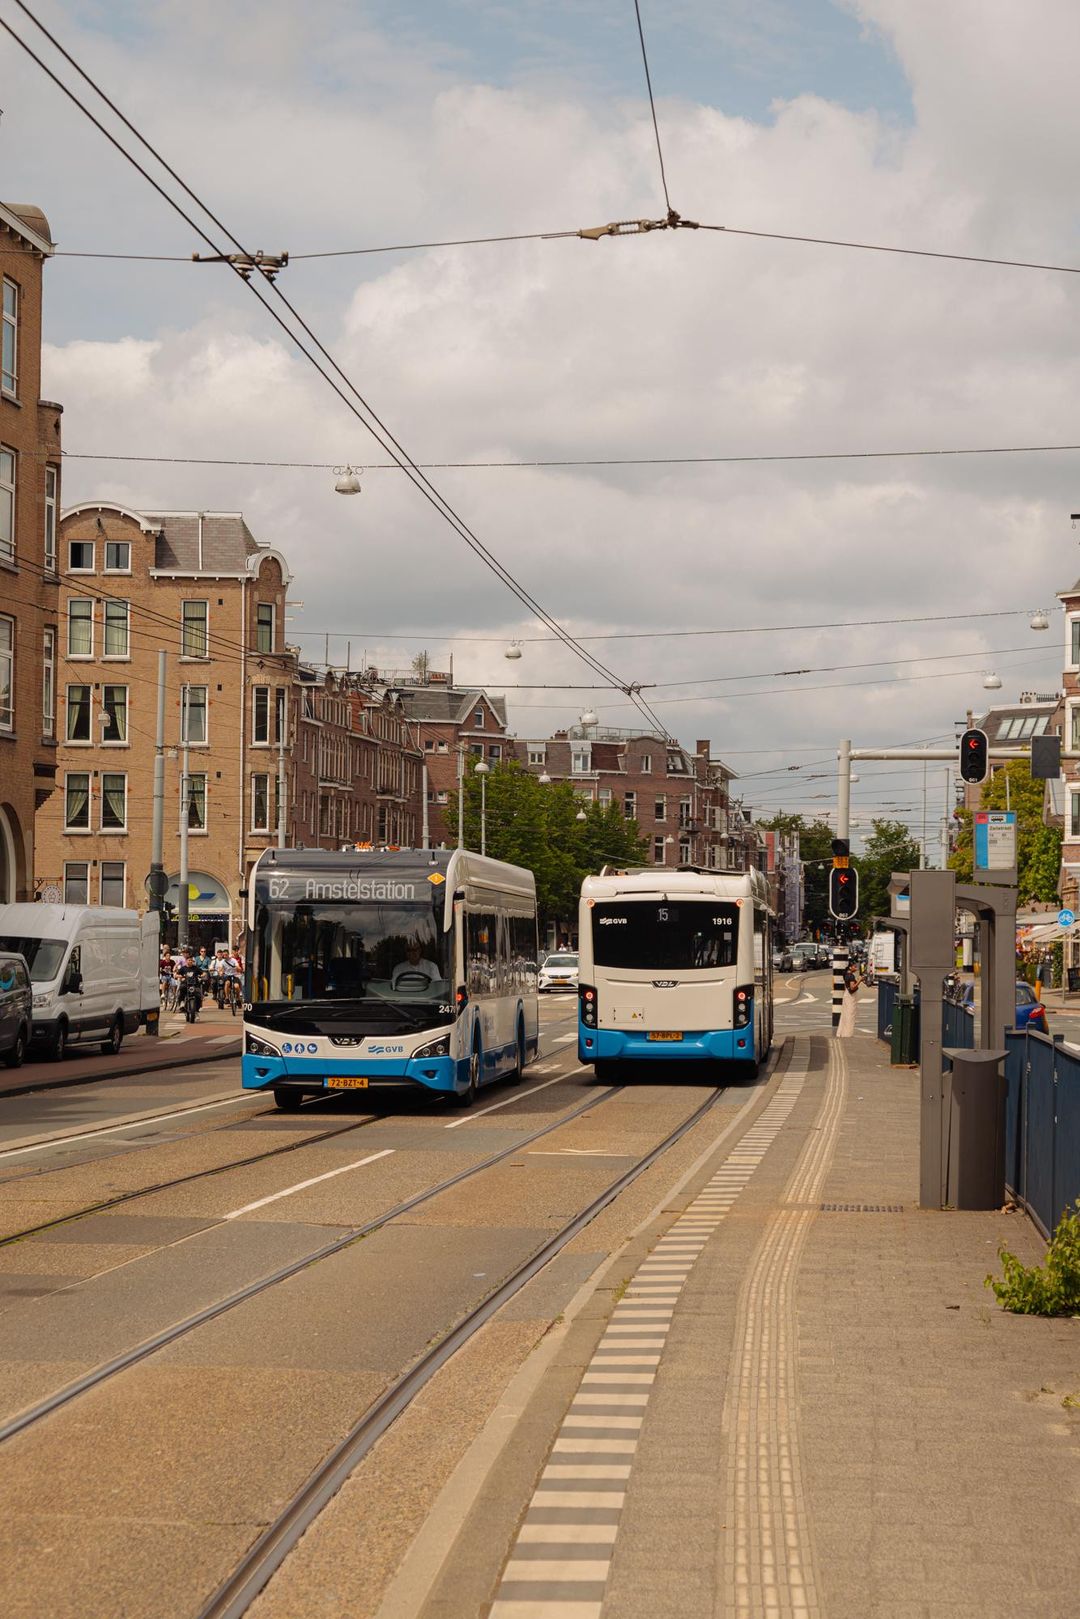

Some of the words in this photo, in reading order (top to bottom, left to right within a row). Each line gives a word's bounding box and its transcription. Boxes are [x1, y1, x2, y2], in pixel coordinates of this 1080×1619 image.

[269, 878, 289, 899] 62
[305, 878, 415, 899] Amstelstation
[658, 908, 669, 921] 15
[712, 917, 733, 926] 1916
